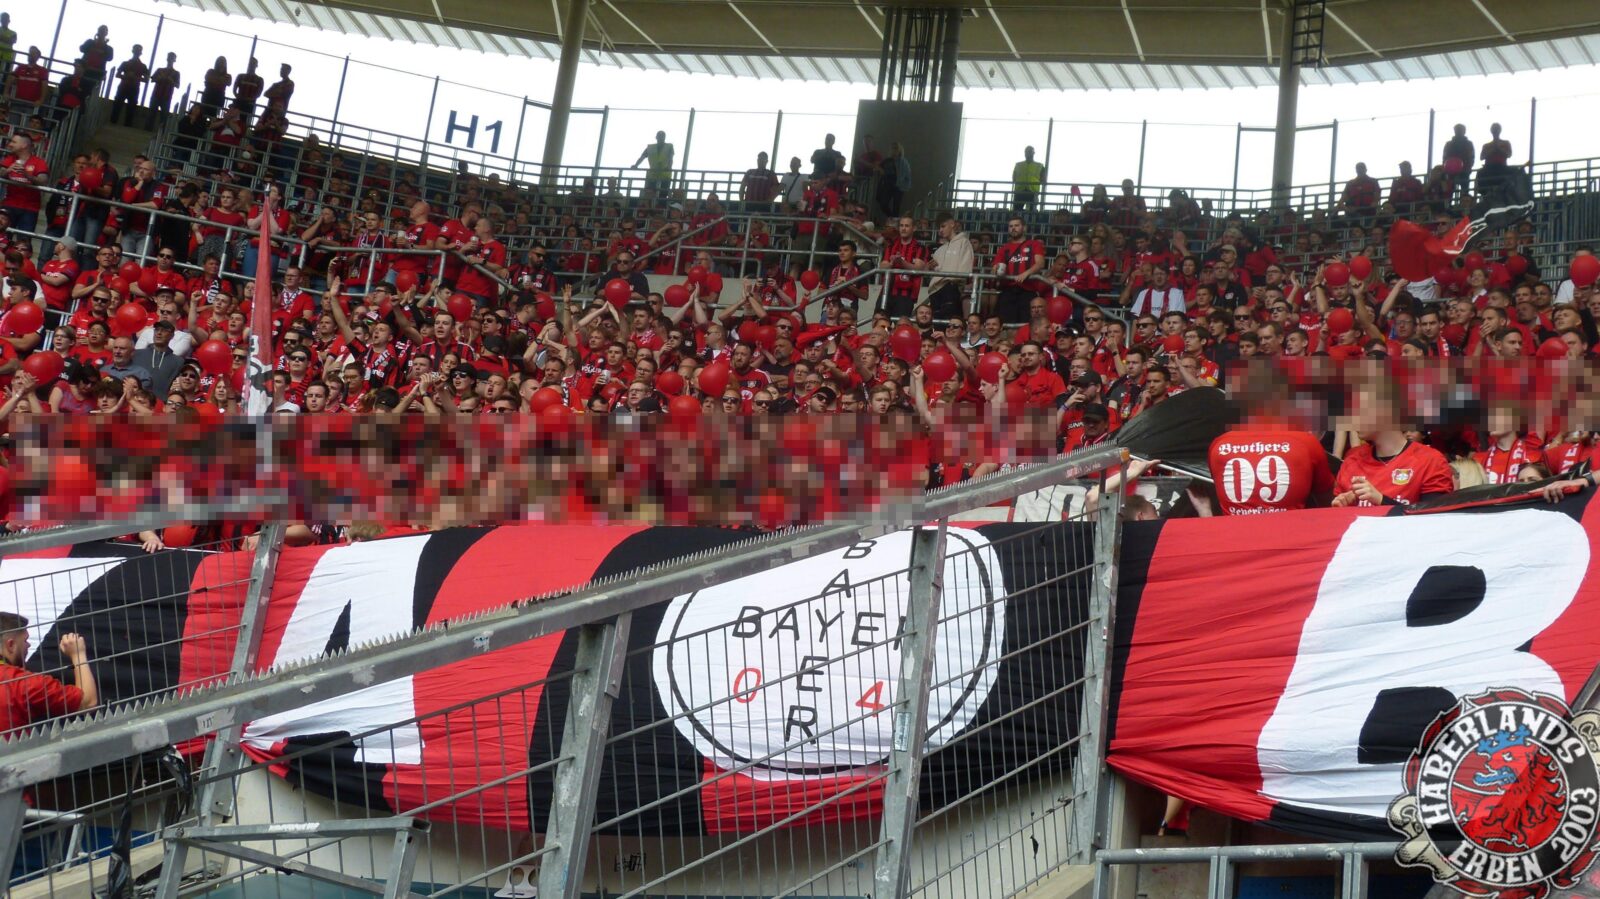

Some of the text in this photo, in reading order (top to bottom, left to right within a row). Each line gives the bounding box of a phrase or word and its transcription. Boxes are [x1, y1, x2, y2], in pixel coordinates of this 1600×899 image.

[445, 109, 503, 154] H1
[1219, 441, 1290, 455] Brothers
[1223, 455, 1290, 503] 09
